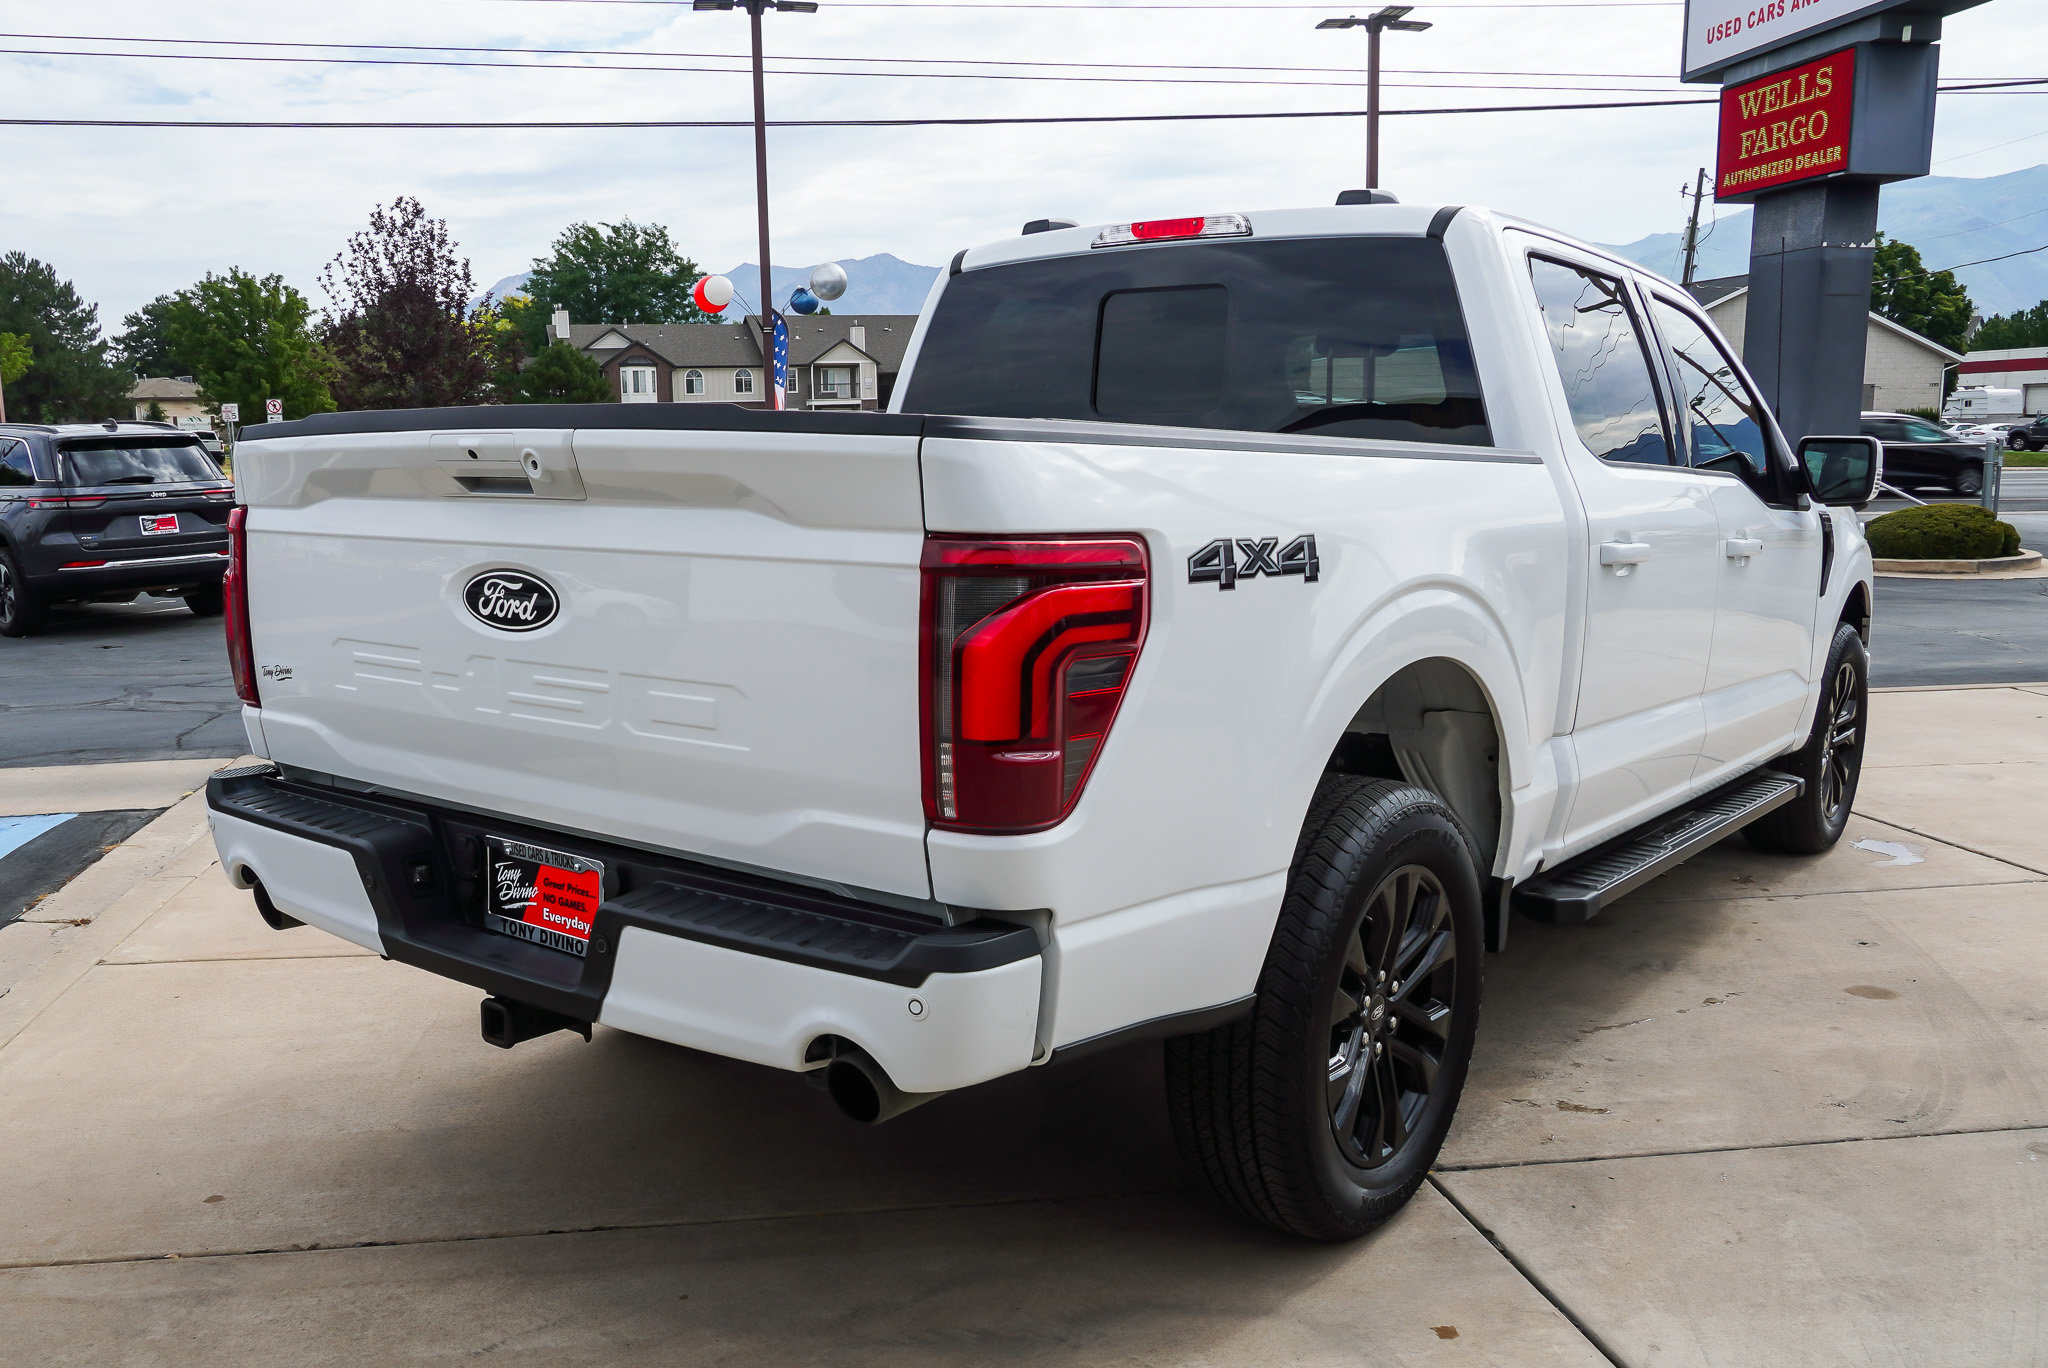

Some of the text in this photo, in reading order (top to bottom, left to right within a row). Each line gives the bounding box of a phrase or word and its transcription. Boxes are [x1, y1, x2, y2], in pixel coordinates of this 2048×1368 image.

[1707, 17, 1742, 45] USED
[1747, 0, 1785, 29] CARS
[1738, 65, 1833, 120] WELLS
[1738, 109, 1829, 160] FARGO
[1722, 145, 1842, 187] AUTHORIZED DEALER
[478, 578, 538, 621] Ford
[495, 861, 522, 886] Tony
[527, 845, 544, 863] CARS
[550, 852, 575, 870] TRUCKS
[496, 881, 539, 901] Divino
[543, 877, 565, 891] Great
[543, 892, 556, 905] NO
[502, 919, 584, 954] TONY DIVINO
